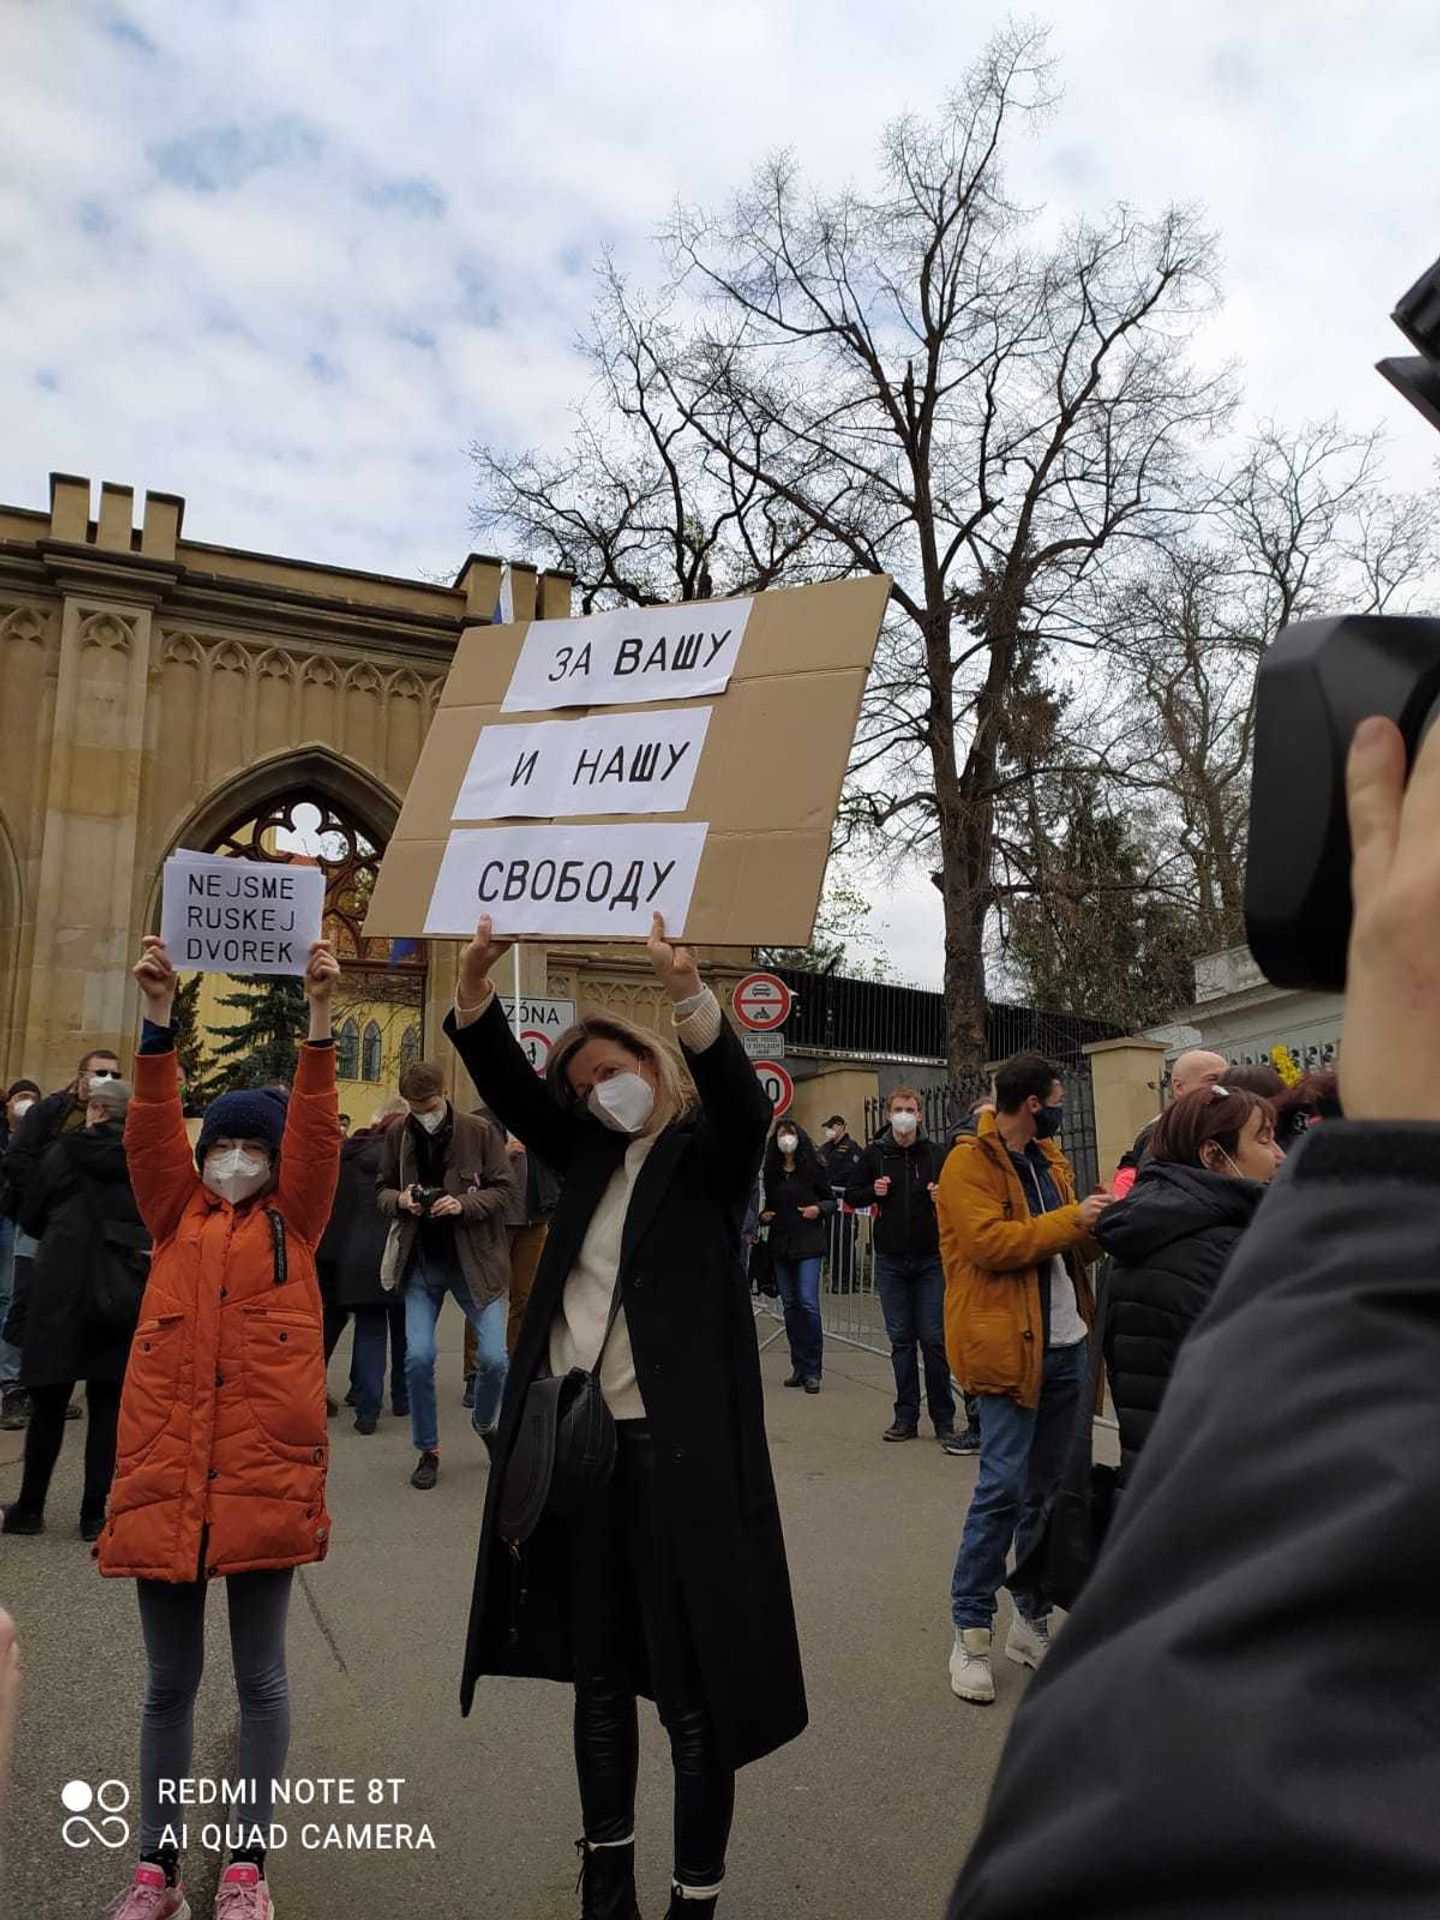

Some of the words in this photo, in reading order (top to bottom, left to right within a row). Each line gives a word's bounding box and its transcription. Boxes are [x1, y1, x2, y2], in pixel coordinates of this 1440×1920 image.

[548, 641, 593, 682] ЗА
[613, 628, 733, 676] ВАШУ
[510, 750, 540, 787] И
[572, 741, 691, 786] НАШУ
[188, 873, 295, 900] NEJSME
[477, 859, 676, 911] СВОБОДУ
[187, 906, 295, 932] RUSKEJ
[186, 938, 293, 964] DVOREK
